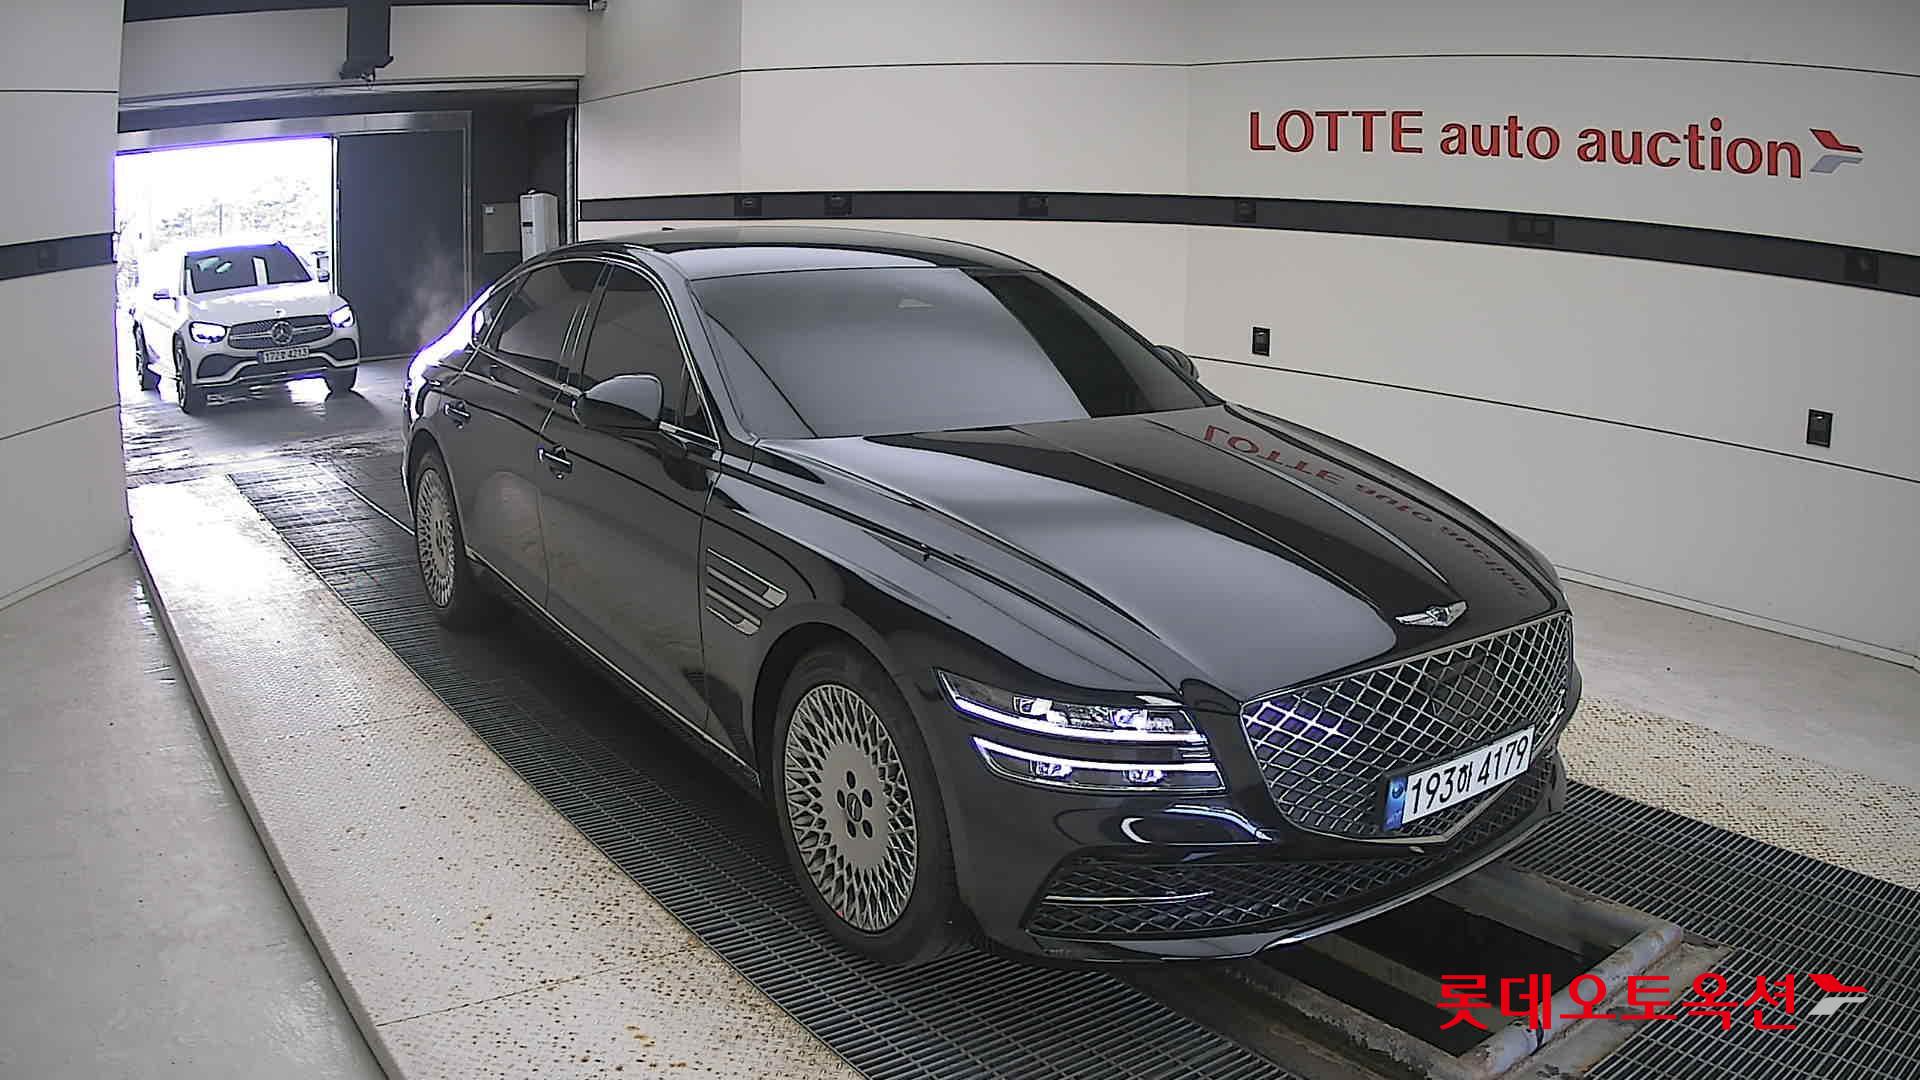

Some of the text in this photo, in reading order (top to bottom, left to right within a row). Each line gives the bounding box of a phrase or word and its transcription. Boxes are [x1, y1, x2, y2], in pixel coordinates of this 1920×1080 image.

[1248, 110, 1803, 179] LOTTE auto auction
[1411, 735, 1529, 815] 193하 4179
